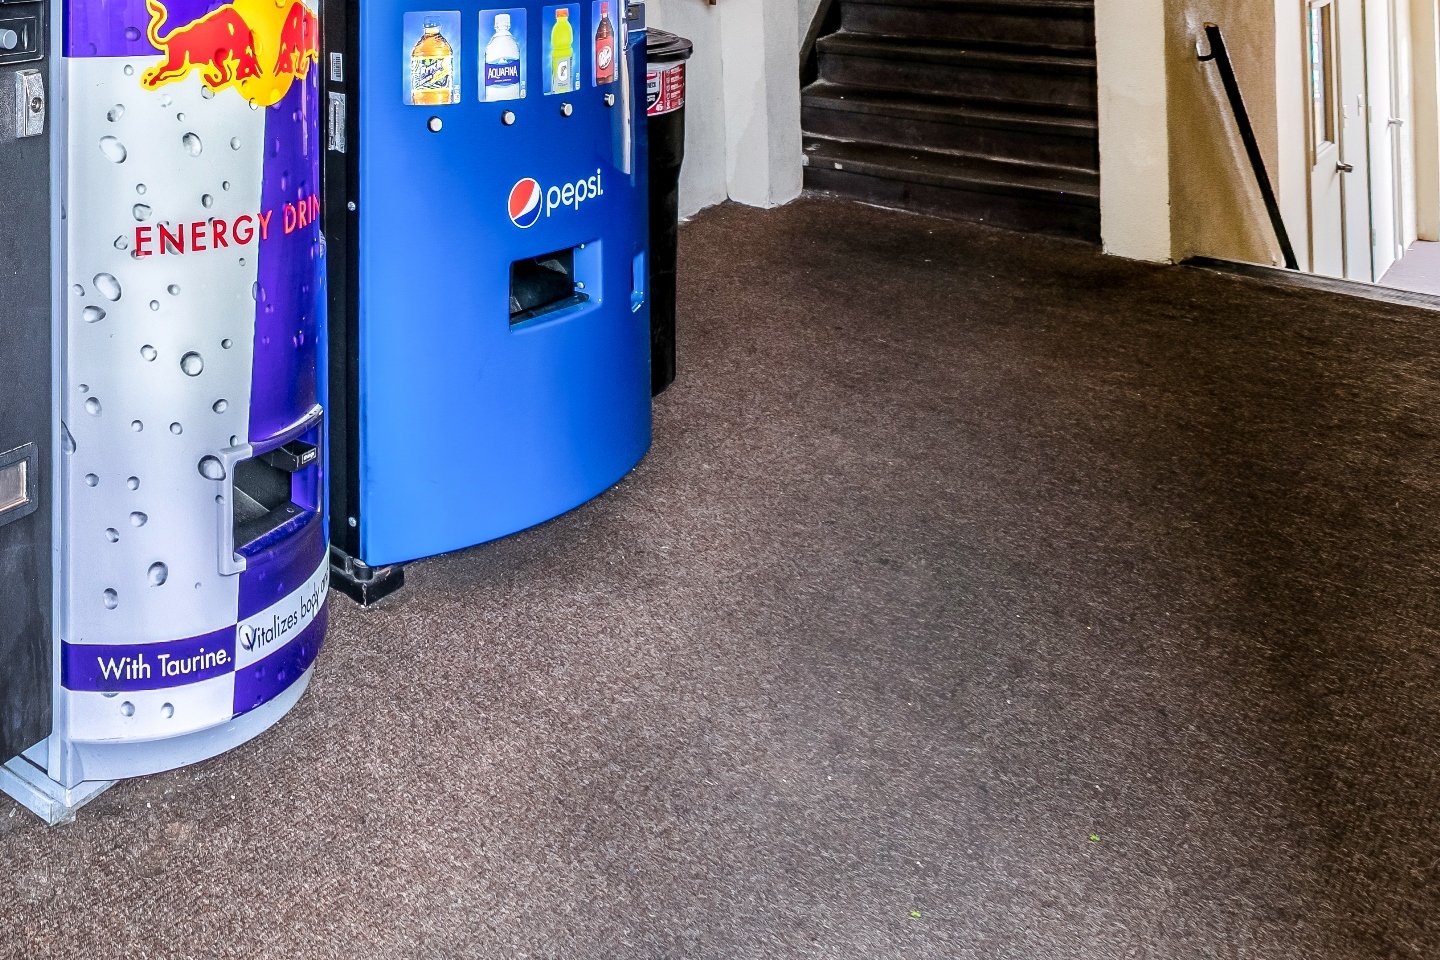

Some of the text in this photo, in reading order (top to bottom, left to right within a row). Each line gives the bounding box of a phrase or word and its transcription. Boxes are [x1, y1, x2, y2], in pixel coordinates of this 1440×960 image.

[488, 65, 518, 80] AQUAFINA
[547, 168, 601, 217] pepsi
[135, 193, 320, 257] ENERGY DRIN
[97, 654, 151, 680] With
[158, 648, 231, 677] Taurine.
[245, 610, 298, 652] Vitalizes
